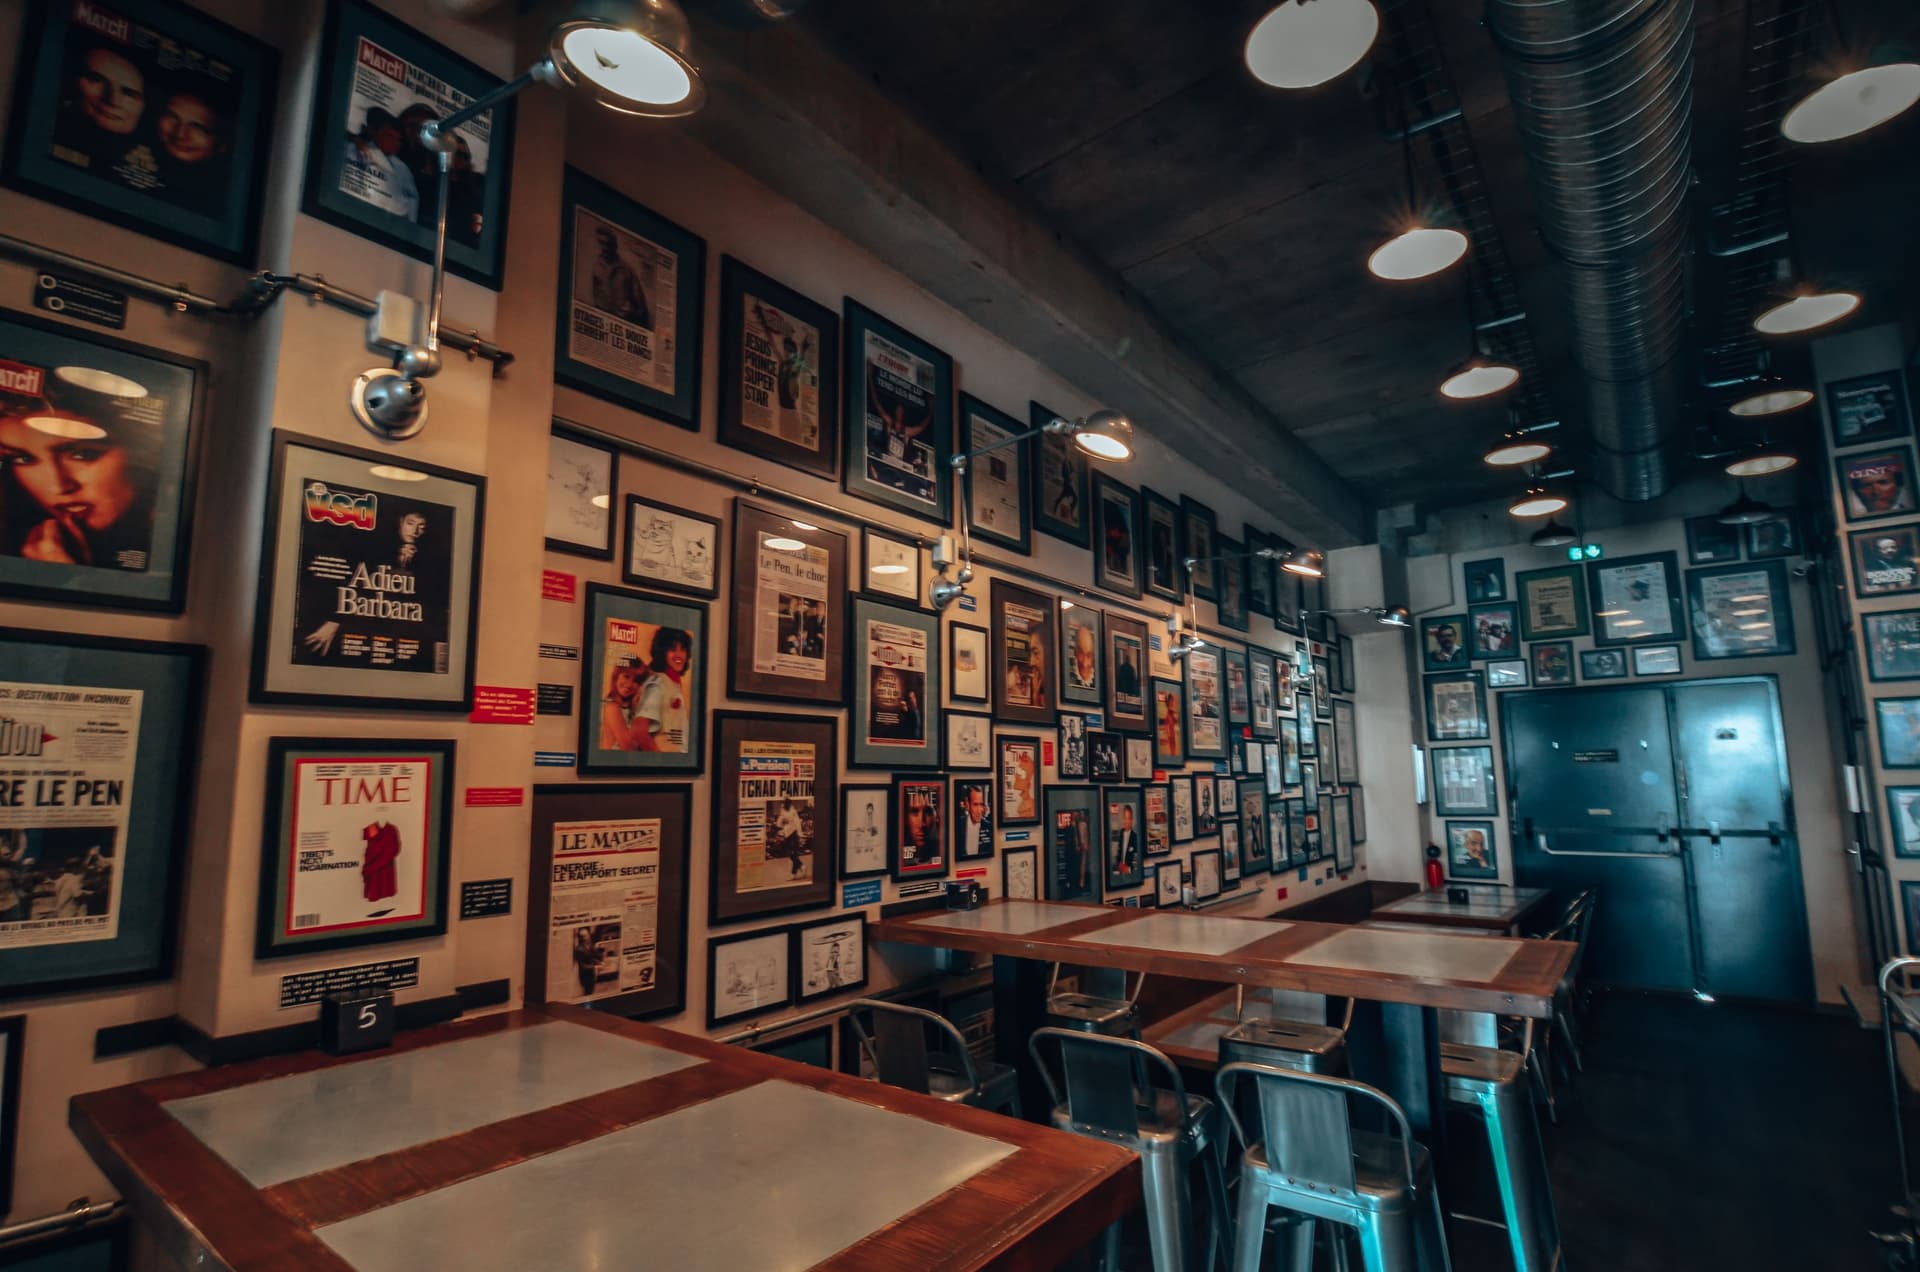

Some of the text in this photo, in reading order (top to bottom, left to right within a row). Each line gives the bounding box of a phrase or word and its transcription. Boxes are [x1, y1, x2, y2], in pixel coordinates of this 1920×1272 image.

[362, 44, 404, 80] MATCH
[348, 561, 417, 595] Adieu
[335, 586, 424, 622] Barbara
[611, 623, 637, 643] MATCH
[1008, 750, 1029, 763] TIME
[35, 779, 67, 807] LE
[73, 780, 124, 807] PEN
[315, 776, 412, 806] TIME
[779, 779, 816, 798] PANTIN
[904, 790, 937, 808] TIME
[1057, 812, 1072, 827] LIFE
[560, 832, 588, 852] LE
[300, 849, 335, 858] TIBET'S
[300, 856, 324, 865] NEXT
[299, 860, 360, 873] INCARNATION
[552, 865, 658, 883] LE RAPPORT SECRET
[553, 862, 600, 874] ENERGIE
[357, 1002, 378, 1029] 5
